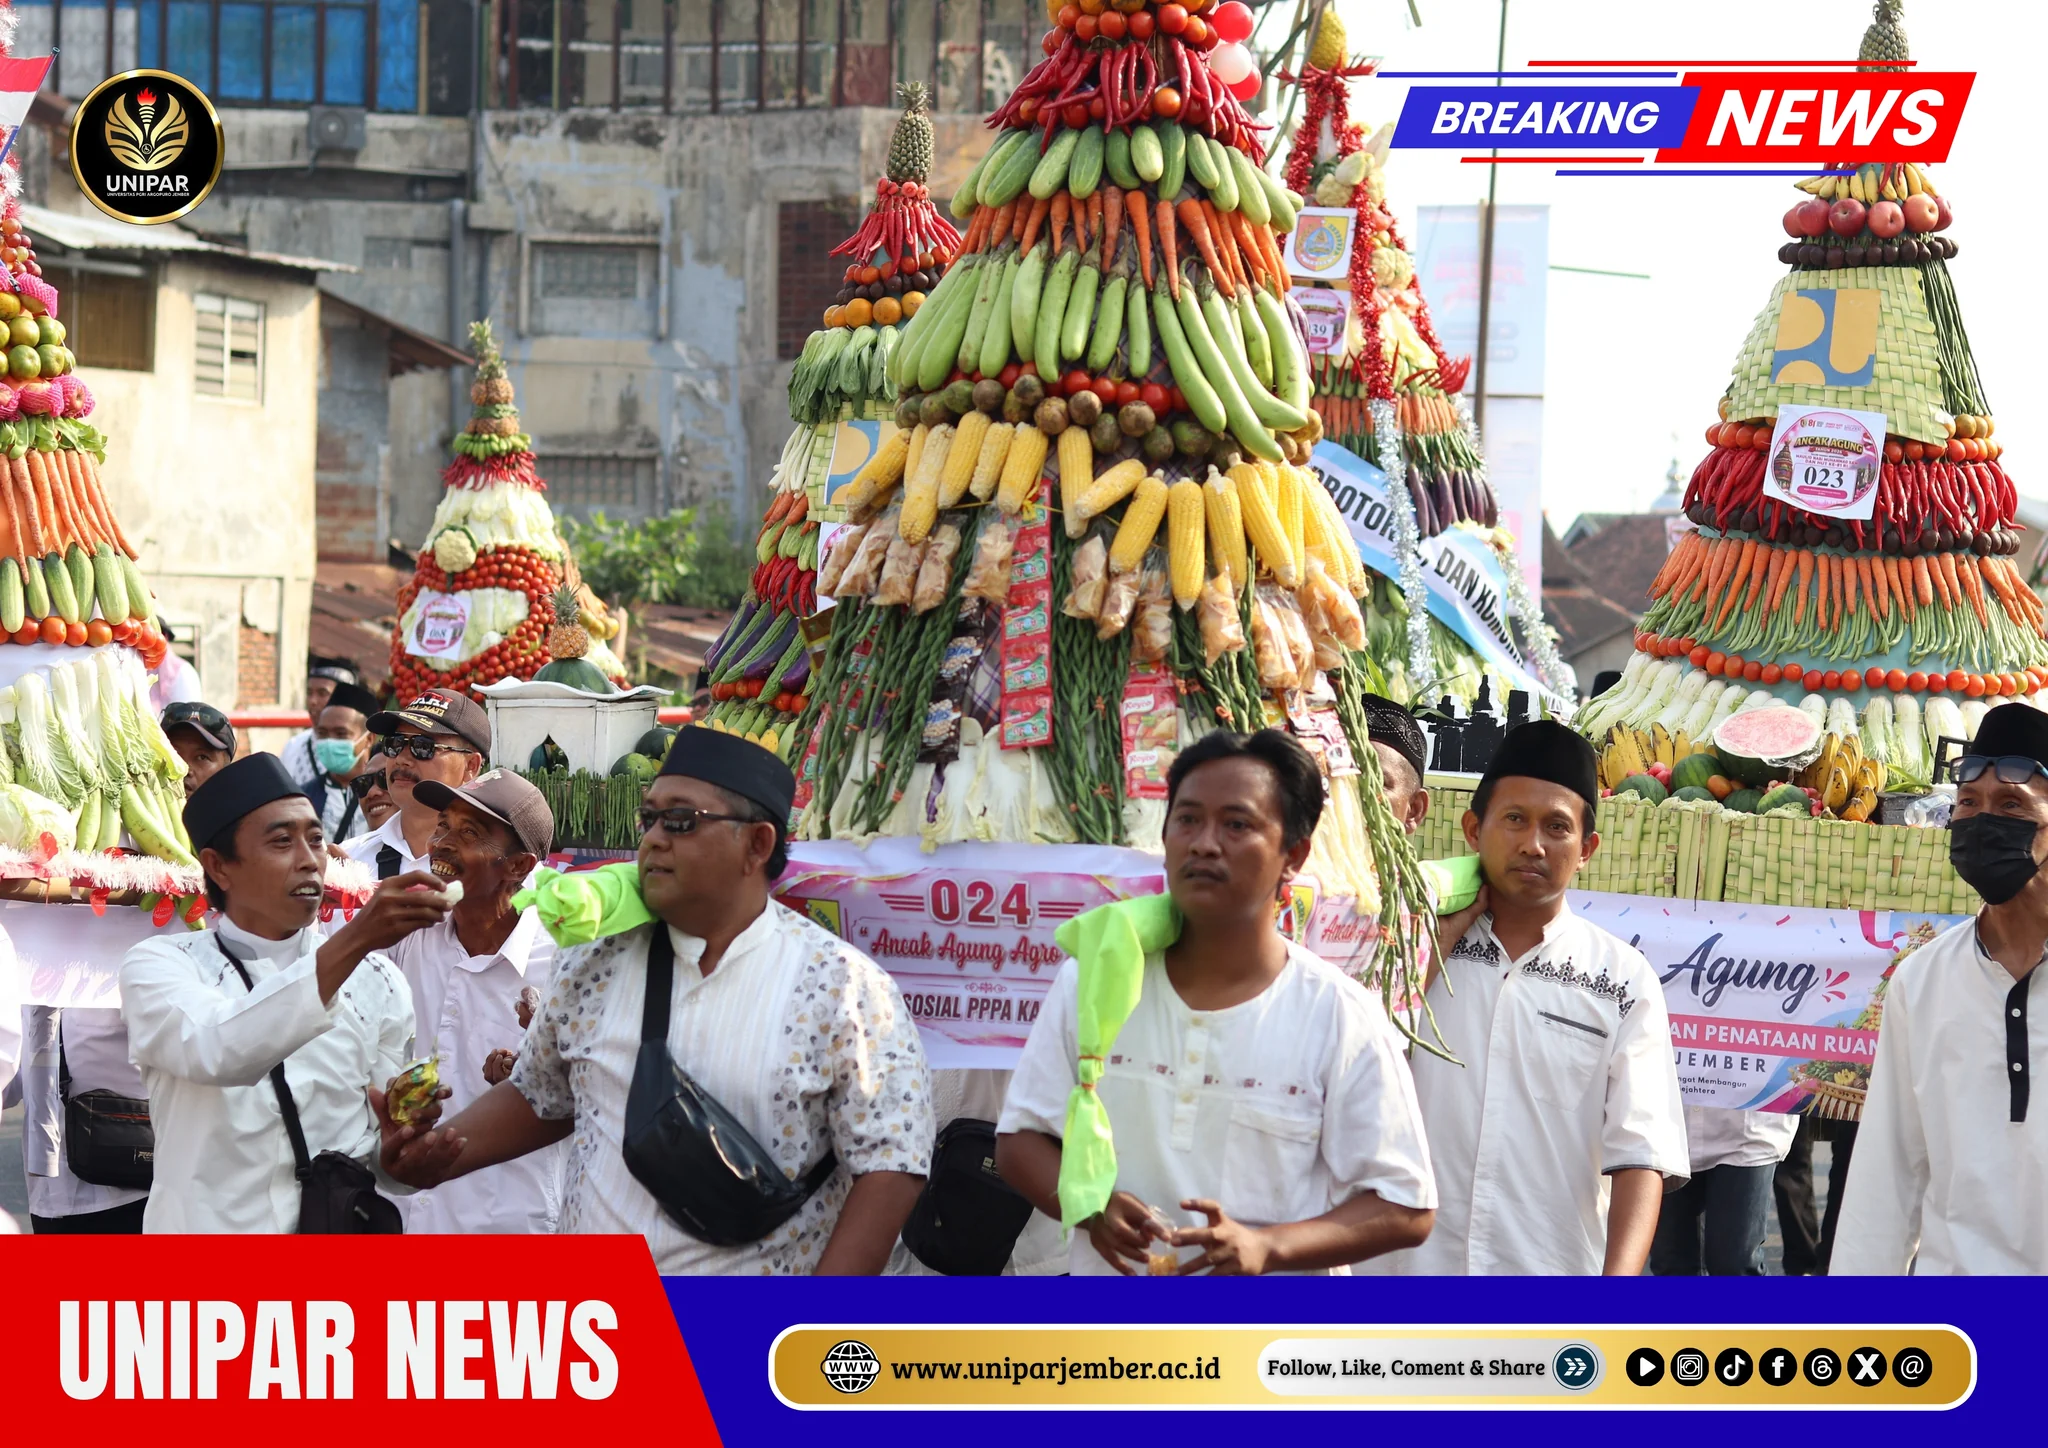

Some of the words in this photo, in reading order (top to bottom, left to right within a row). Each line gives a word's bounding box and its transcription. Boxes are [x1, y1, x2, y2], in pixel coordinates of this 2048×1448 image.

[1794, 436, 1829, 447] ANCAK
[1831, 438, 1864, 454] AGUNG
[1804, 466, 1844, 488] 023
[1433, 546, 1479, 601] DAN
[930, 879, 1032, 926] 024
[938, 932, 1004, 970] Agung
[1660, 932, 1819, 1014] Agung
[903, 993, 961, 1018] SOSIAL
[967, 997, 1011, 1021] PPPA
[1705, 1024, 1817, 1051] PENATAAN
[1675, 1051, 1766, 1073] JEMBER
[1680, 1085, 1716, 1094] ejahtera
[1698, 1076, 1747, 1088] Membangun
